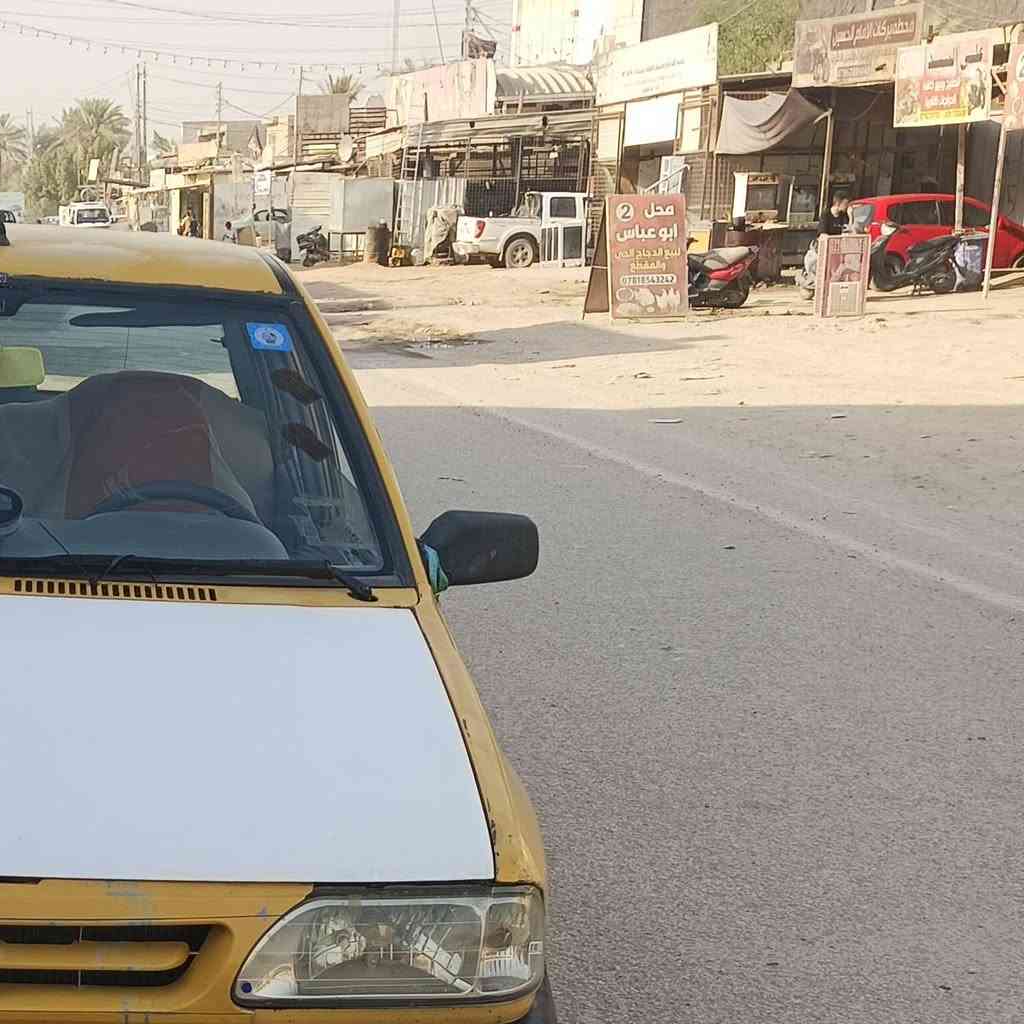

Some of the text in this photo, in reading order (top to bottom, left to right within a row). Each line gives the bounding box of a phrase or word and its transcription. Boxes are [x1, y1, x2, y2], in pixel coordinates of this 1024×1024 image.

[644, 202, 674, 219] محل
[616, 223, 678, 242] ابو عباس
[636, 247, 663, 260] الدجاج
